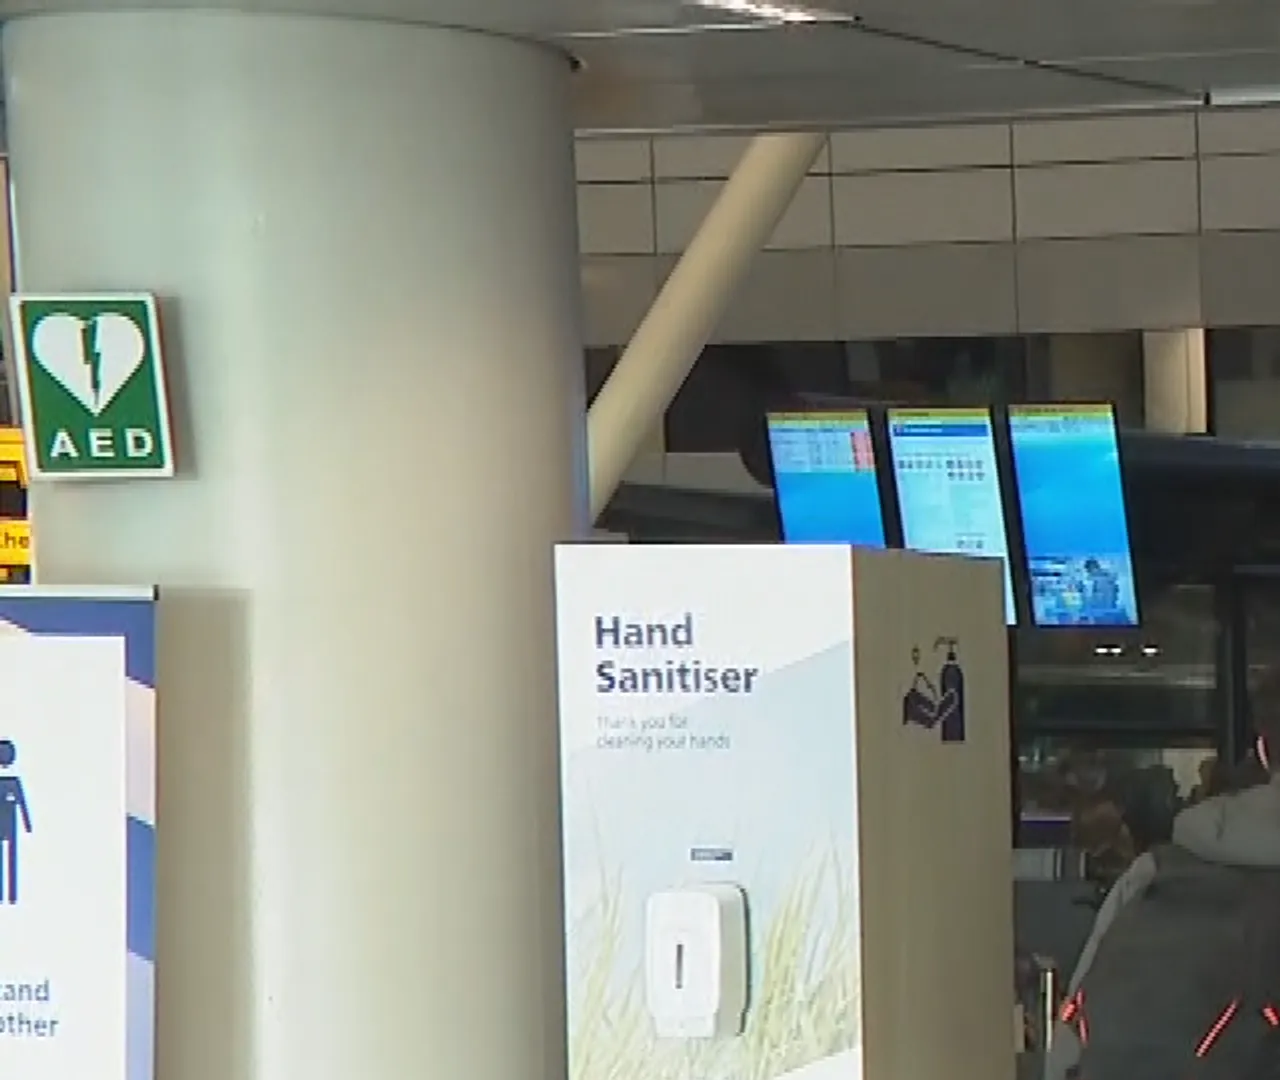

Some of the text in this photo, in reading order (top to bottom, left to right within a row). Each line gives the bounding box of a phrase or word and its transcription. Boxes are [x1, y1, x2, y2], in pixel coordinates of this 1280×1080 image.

[50, 427, 153, 458] AED
[595, 612, 693, 648] Hand
[596, 659, 759, 693] Sanitiser
[641, 717, 666, 732] you
[597, 731, 731, 752] cleaning your hands
[0, 976, 50, 1002] and
